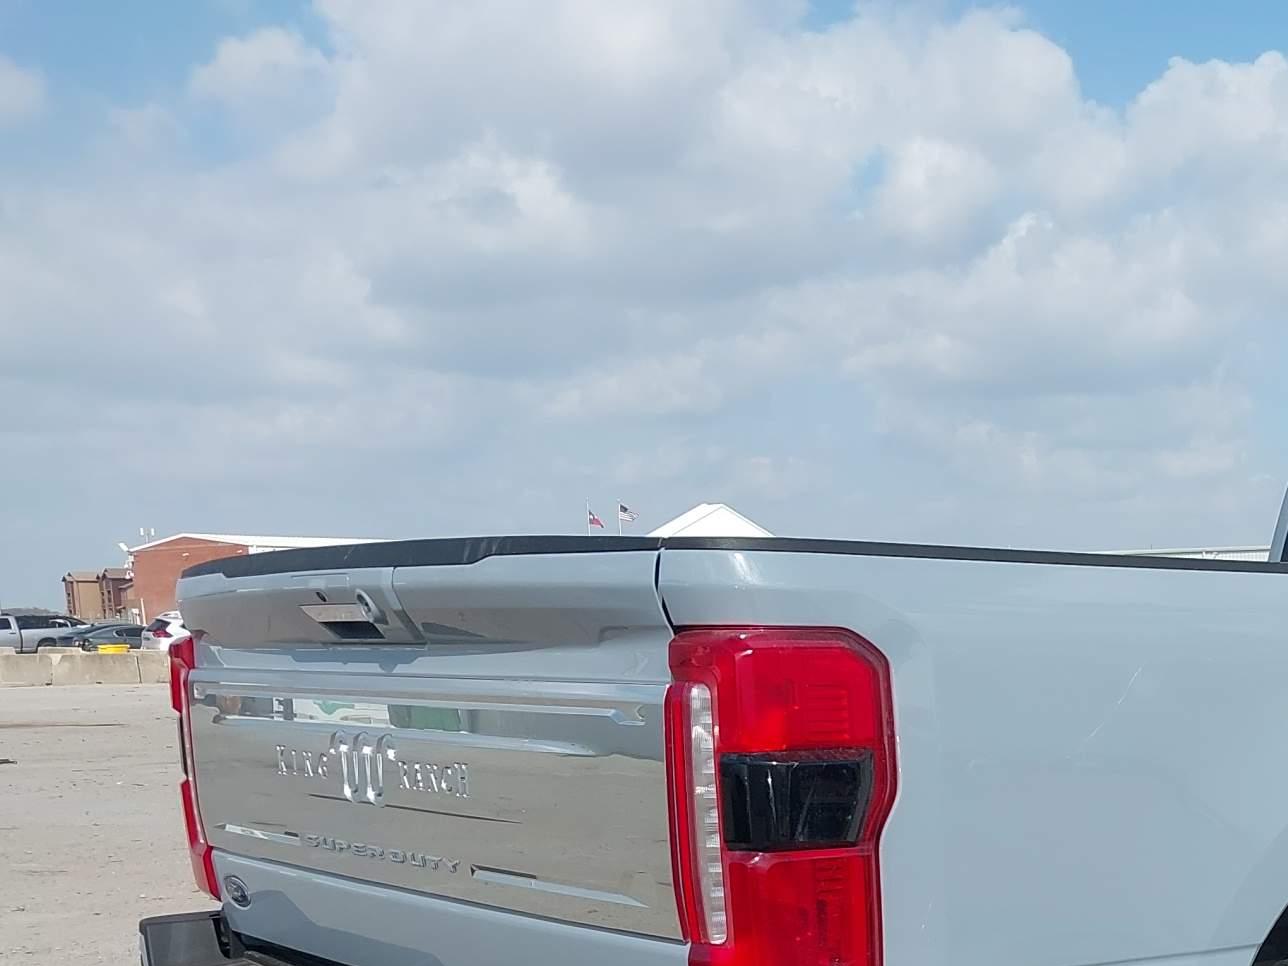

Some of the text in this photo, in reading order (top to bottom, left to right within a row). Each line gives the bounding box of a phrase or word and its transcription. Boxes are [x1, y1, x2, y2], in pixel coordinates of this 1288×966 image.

[275, 744, 471, 798] KING RANCH
[305, 834, 461, 873] SUPER DUTY
